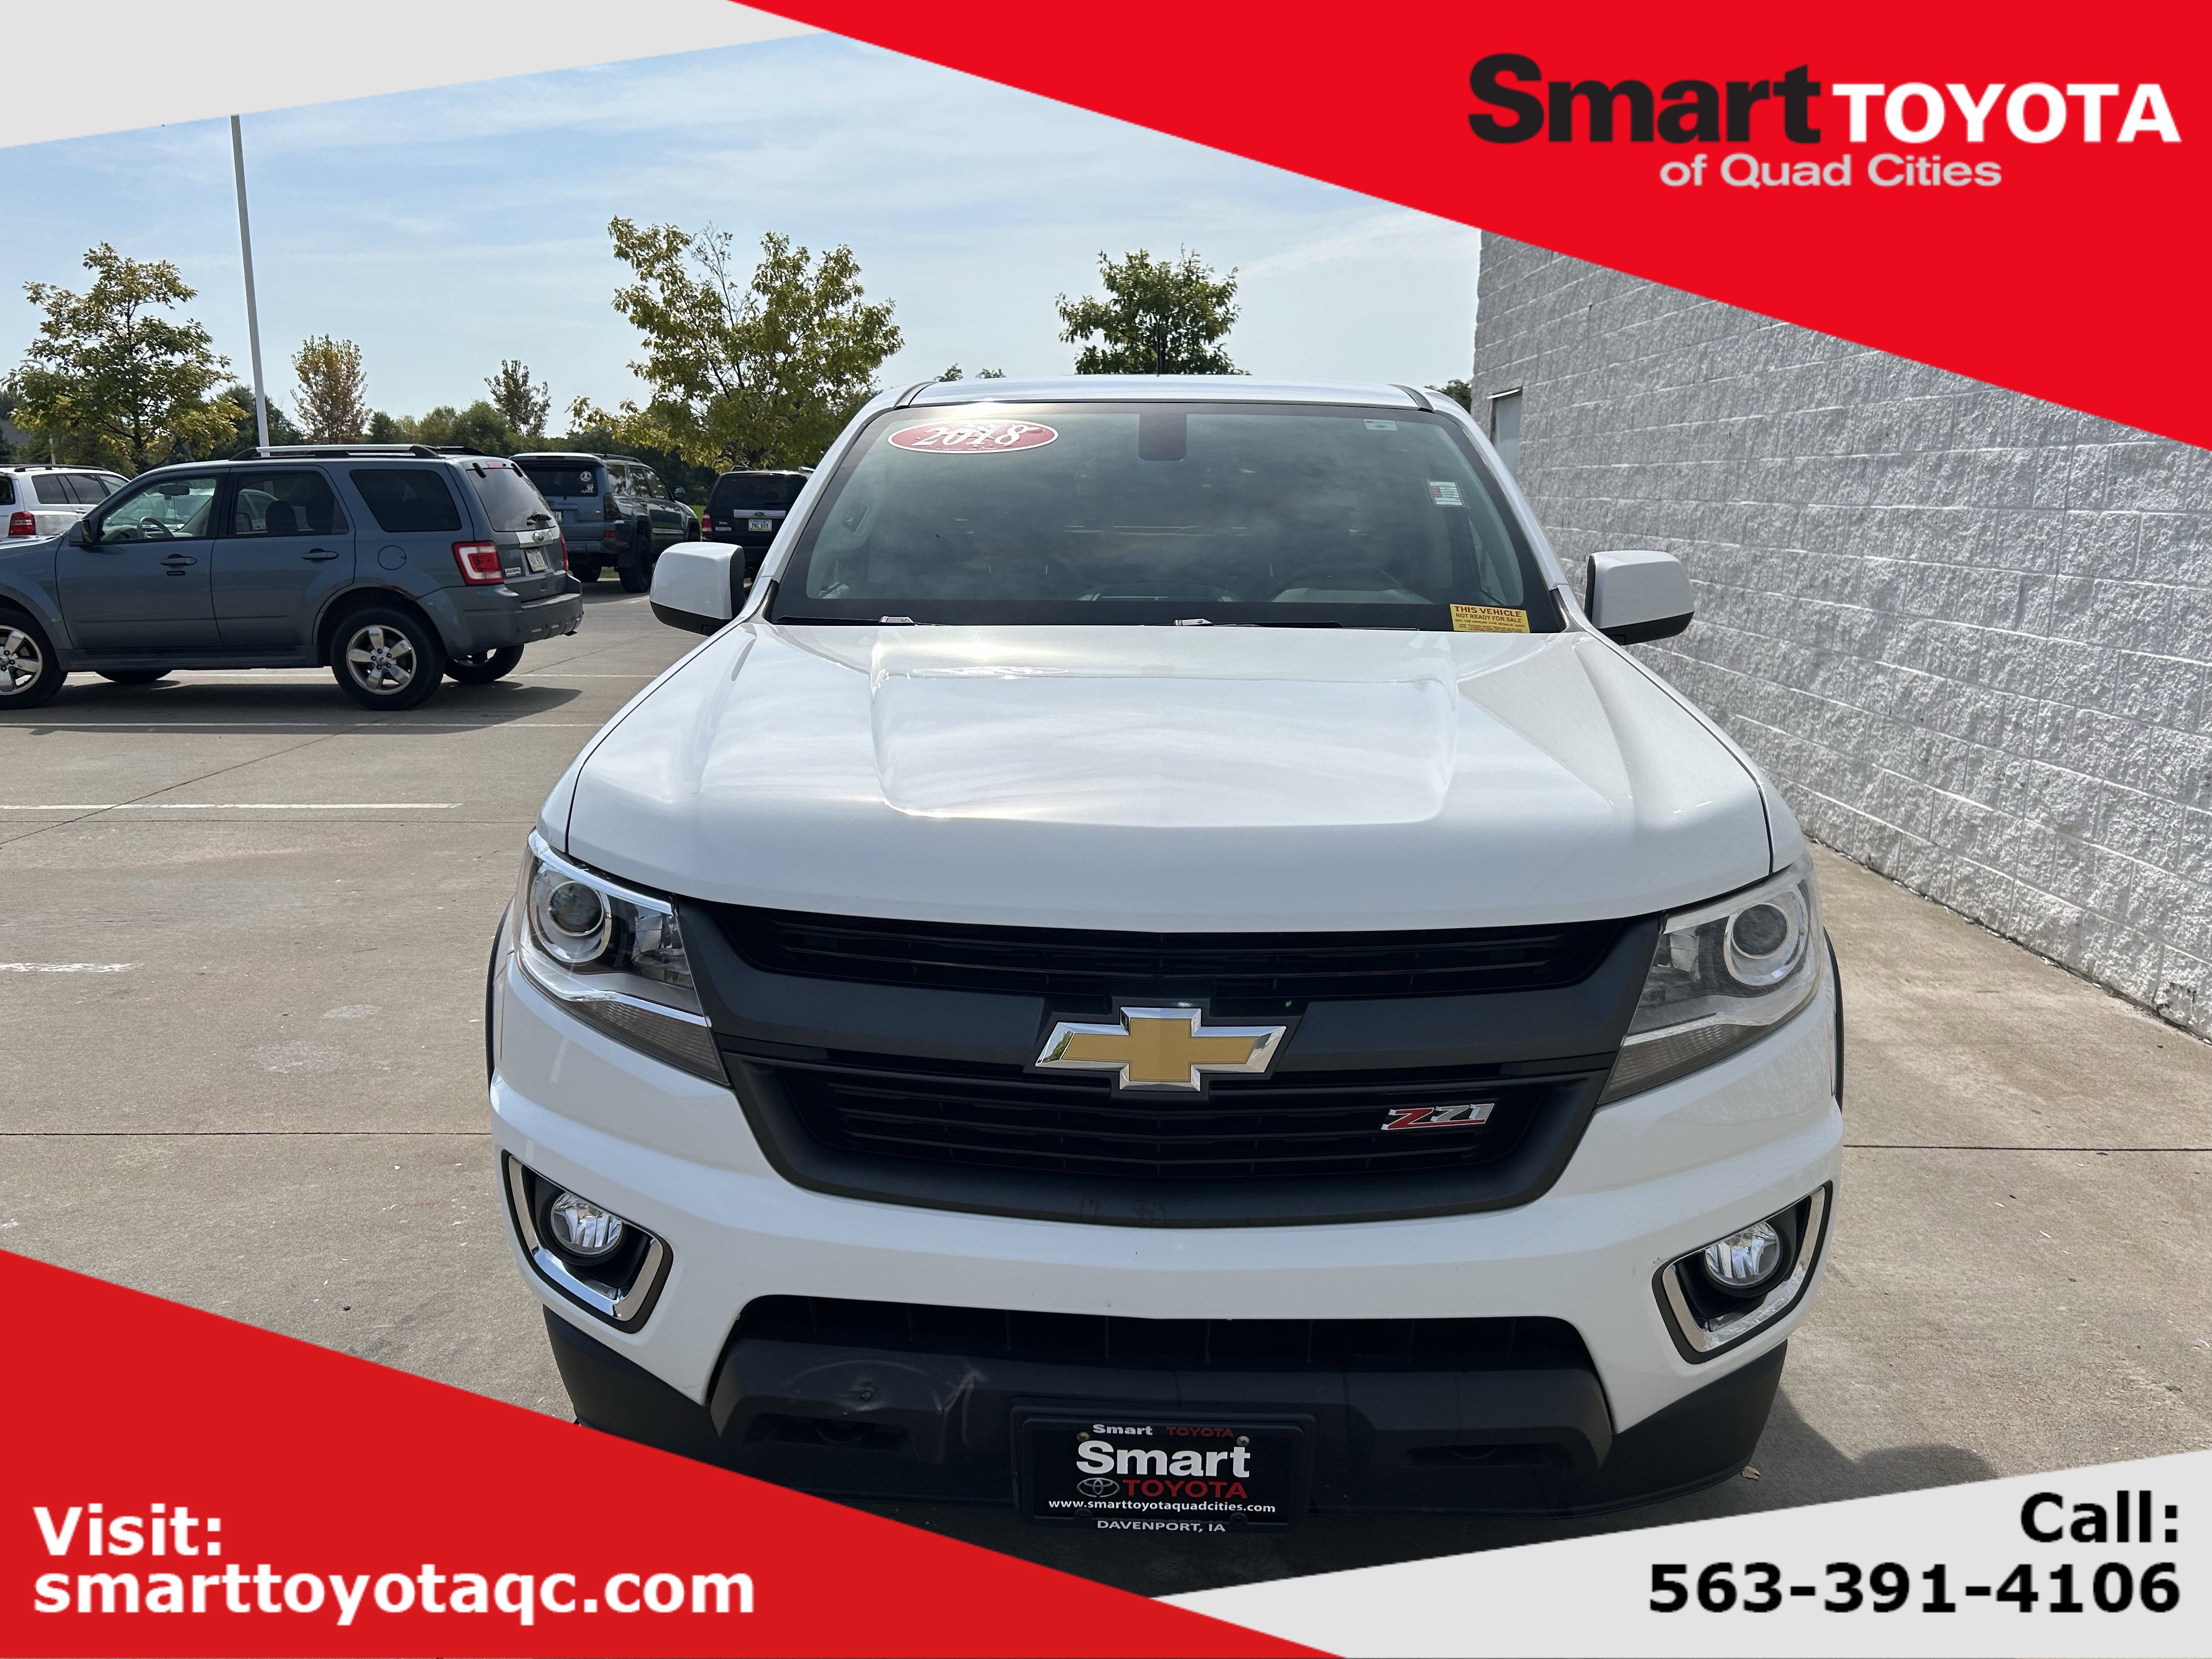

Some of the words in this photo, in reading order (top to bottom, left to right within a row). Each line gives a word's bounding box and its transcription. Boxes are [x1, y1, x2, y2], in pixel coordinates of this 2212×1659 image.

[911, 422, 1040, 446] 2018
[1479, 607, 1522, 617] VEHICLE
[1381, 1103, 1494, 1130] Z71
[1092, 1424, 1153, 1436] Smart
[1166, 1426, 1234, 1438] TOYOTA
[1076, 1440, 1251, 1478] Smart
[1122, 1479, 1248, 1499] TOYOTA
[1048, 1499, 1276, 1513] www.smarttoyotaquadcities.com
[1097, 1520, 1203, 1533] DAVENPORT,
[1209, 1523, 1226, 1532] IA
